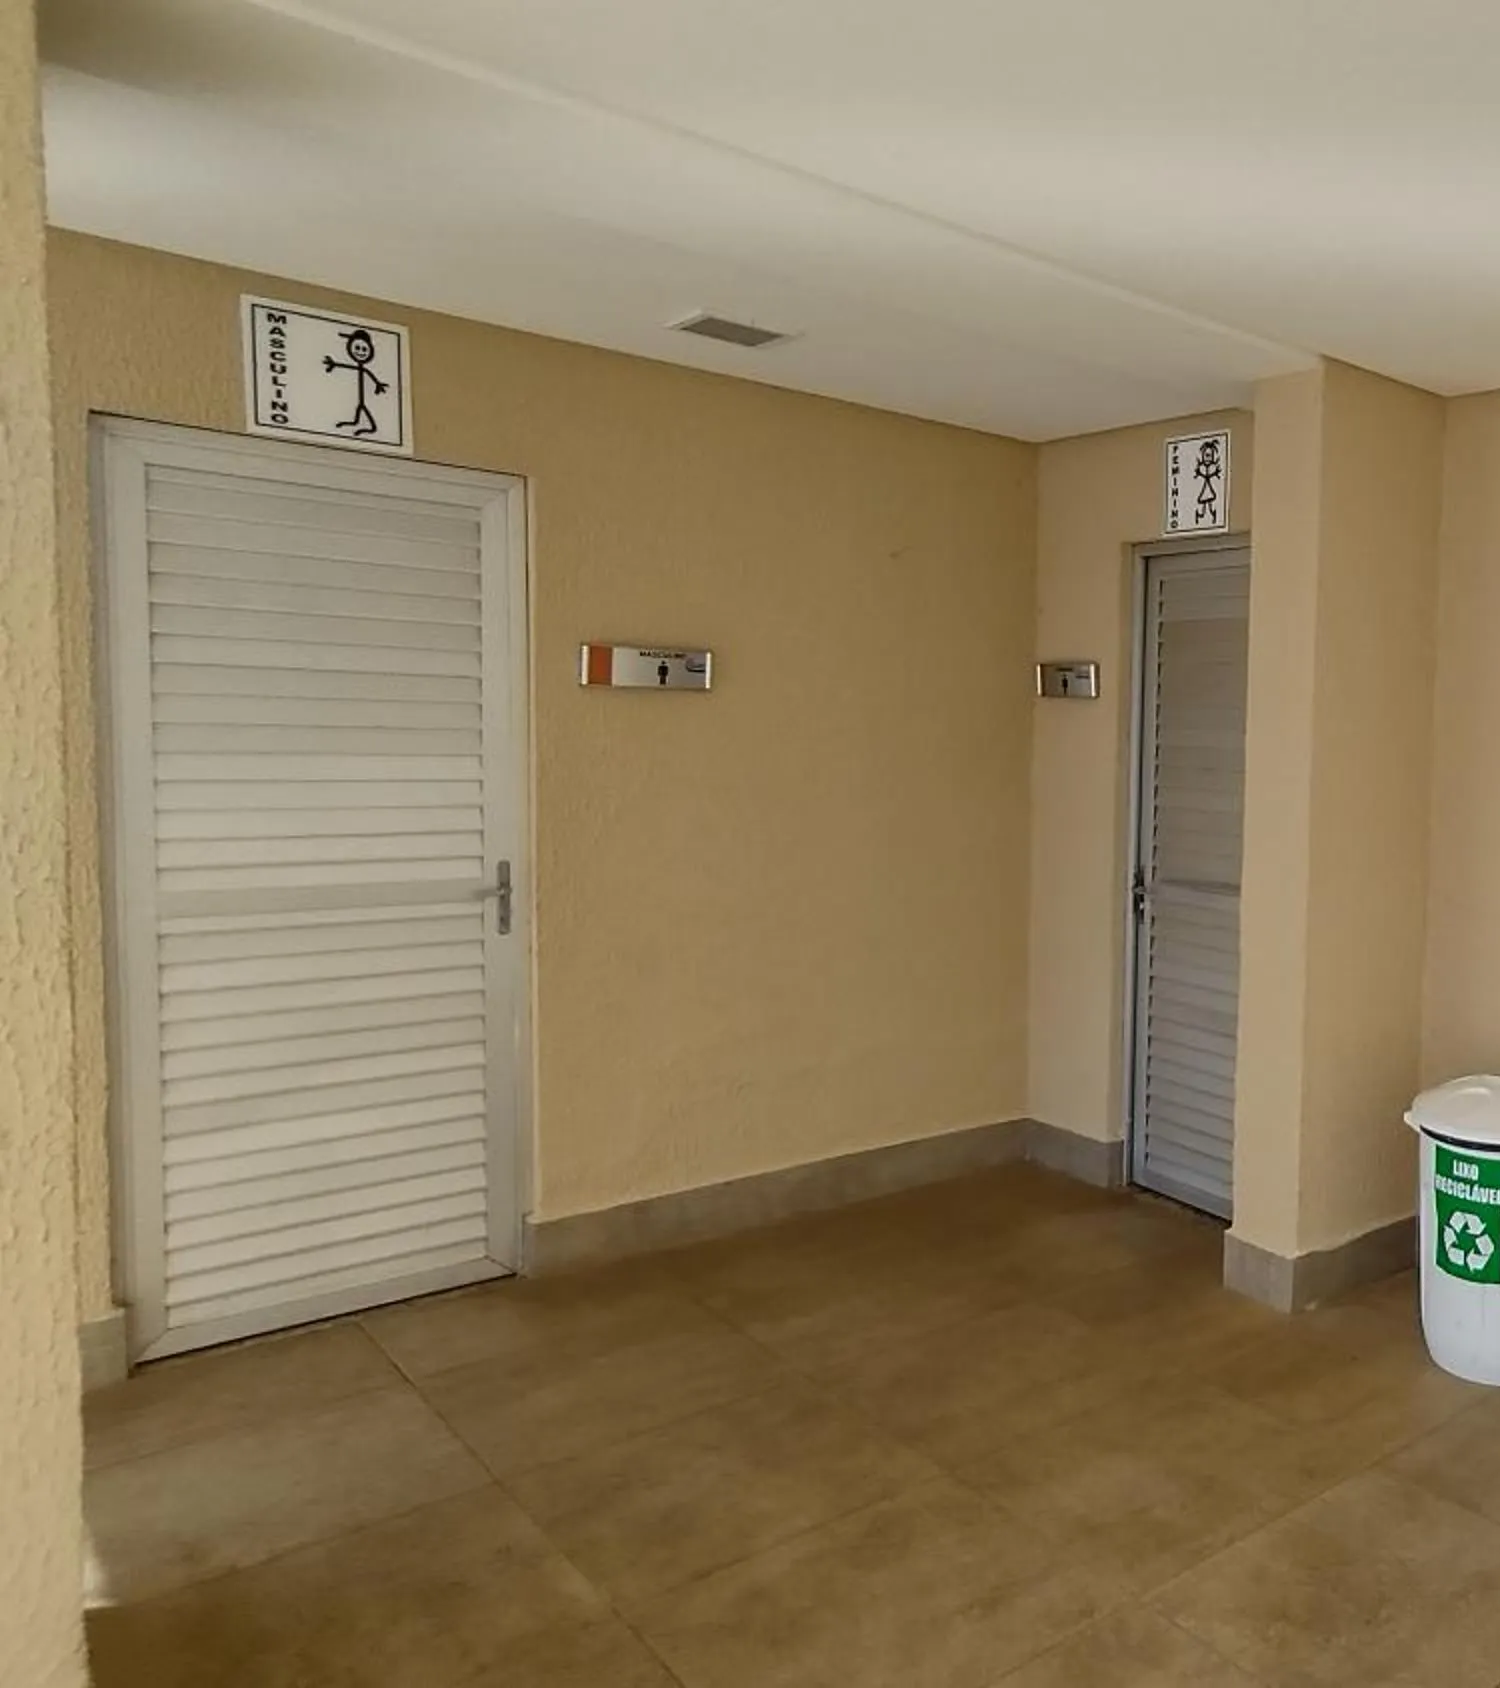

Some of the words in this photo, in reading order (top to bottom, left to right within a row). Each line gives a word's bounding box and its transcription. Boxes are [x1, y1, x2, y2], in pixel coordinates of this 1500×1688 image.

[267, 313, 288, 424] MASCULINO
[1170, 445, 1179, 529] FEMININO
[1453, 1159, 1479, 1181] LIXO
